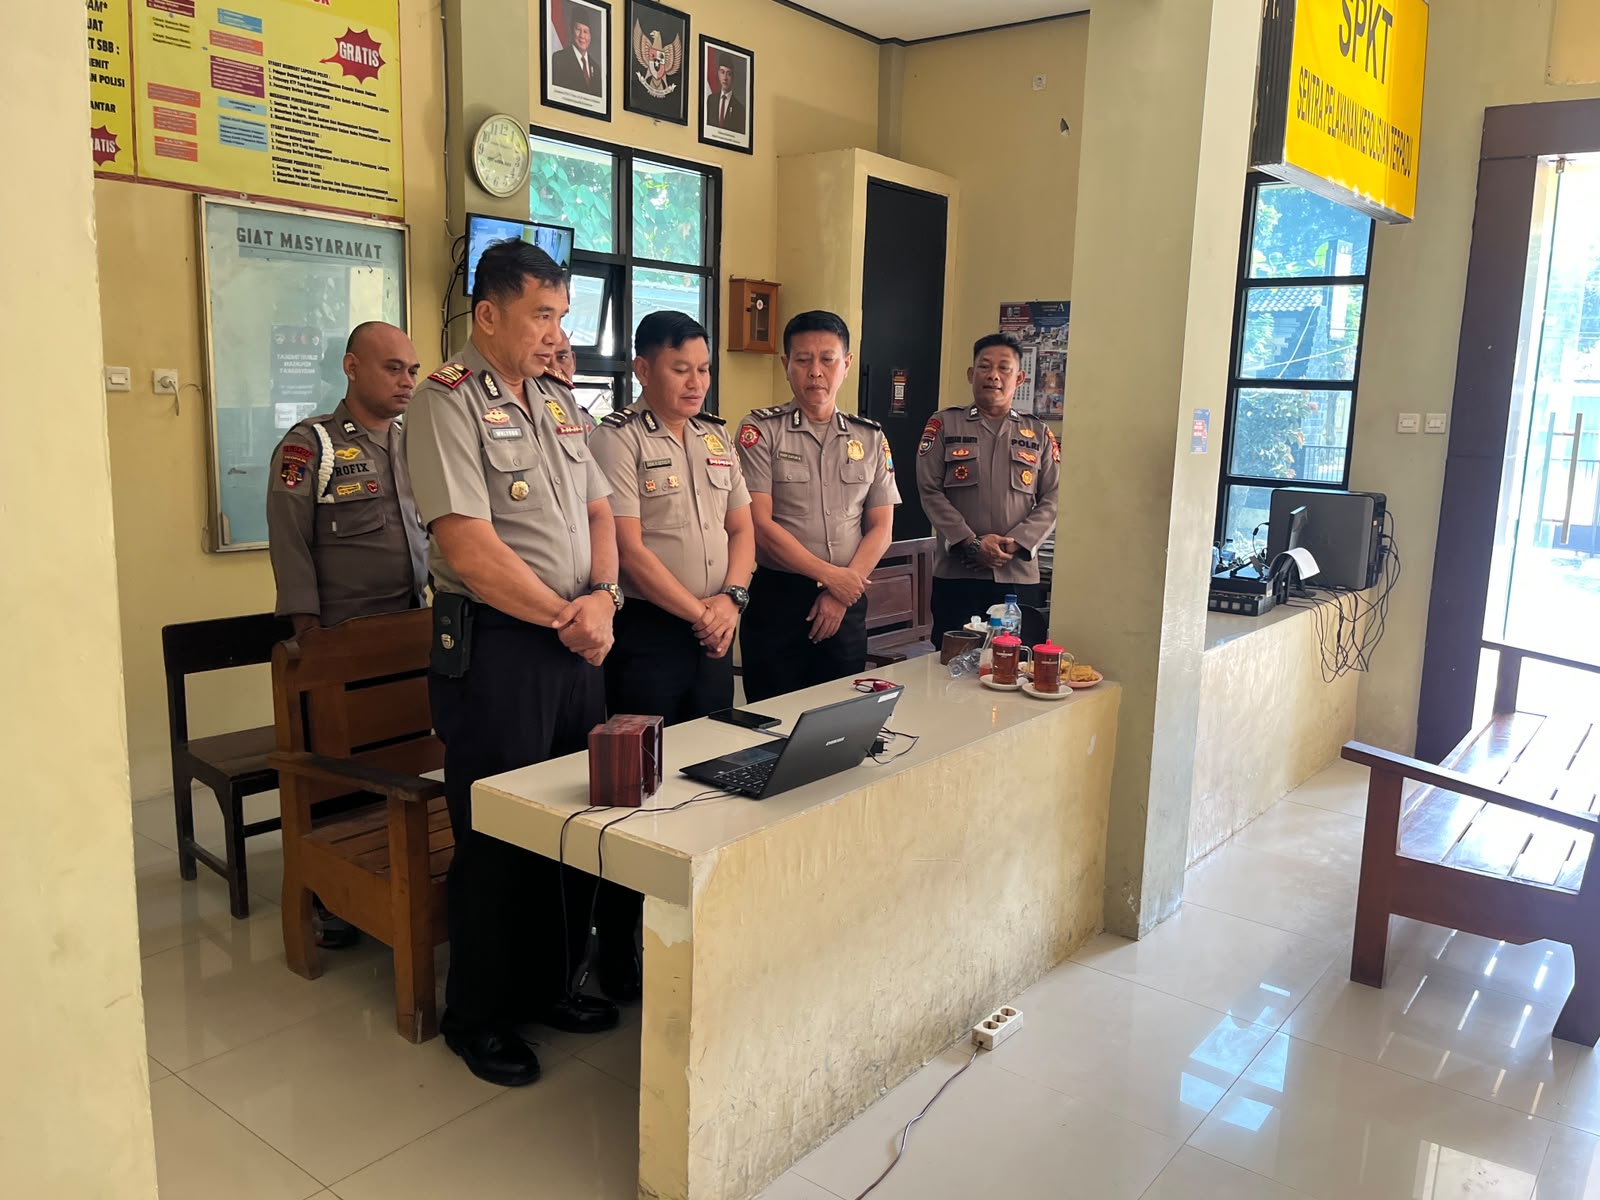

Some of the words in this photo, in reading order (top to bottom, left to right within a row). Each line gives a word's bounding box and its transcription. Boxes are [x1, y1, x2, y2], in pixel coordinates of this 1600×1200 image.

[97, 39, 114, 53] SBB
[1339, 0, 1393, 84] SPKT
[339, 41, 379, 68] GRATIS
[99, 74, 125, 87] POLISI
[500, 123, 508, 136] 12
[93, 138, 116, 153] ATIS
[479, 143, 484, 154] 9
[236, 226, 273, 247] GIAT
[280, 232, 382, 260] MASYARAKAT
[1011, 439, 1039, 451] POLRI
[334, 463, 369, 477] ROFIX
